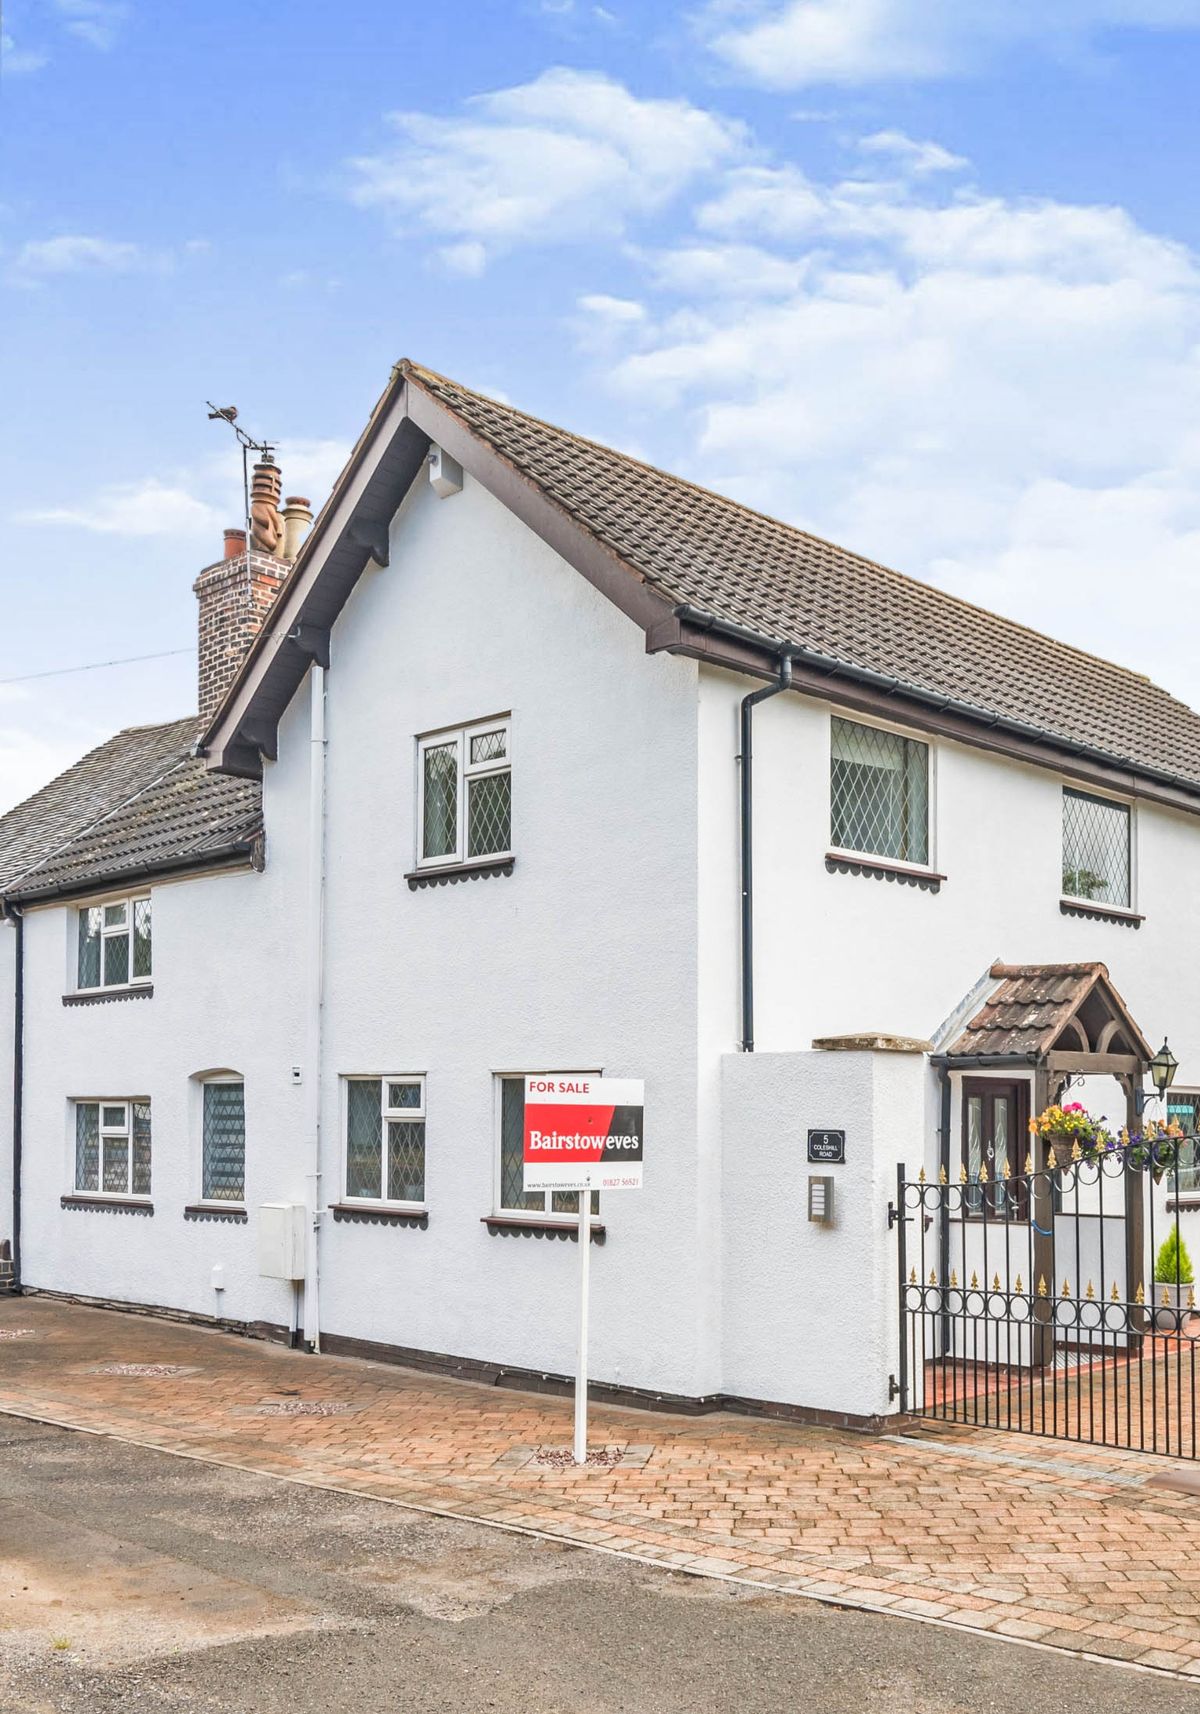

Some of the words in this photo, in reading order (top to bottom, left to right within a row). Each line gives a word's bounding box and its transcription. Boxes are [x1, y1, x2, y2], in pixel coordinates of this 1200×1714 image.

[529, 1081, 555, 1093] FOR
[558, 1082, 590, 1094] SALE
[824, 1135, 828, 1144] 5
